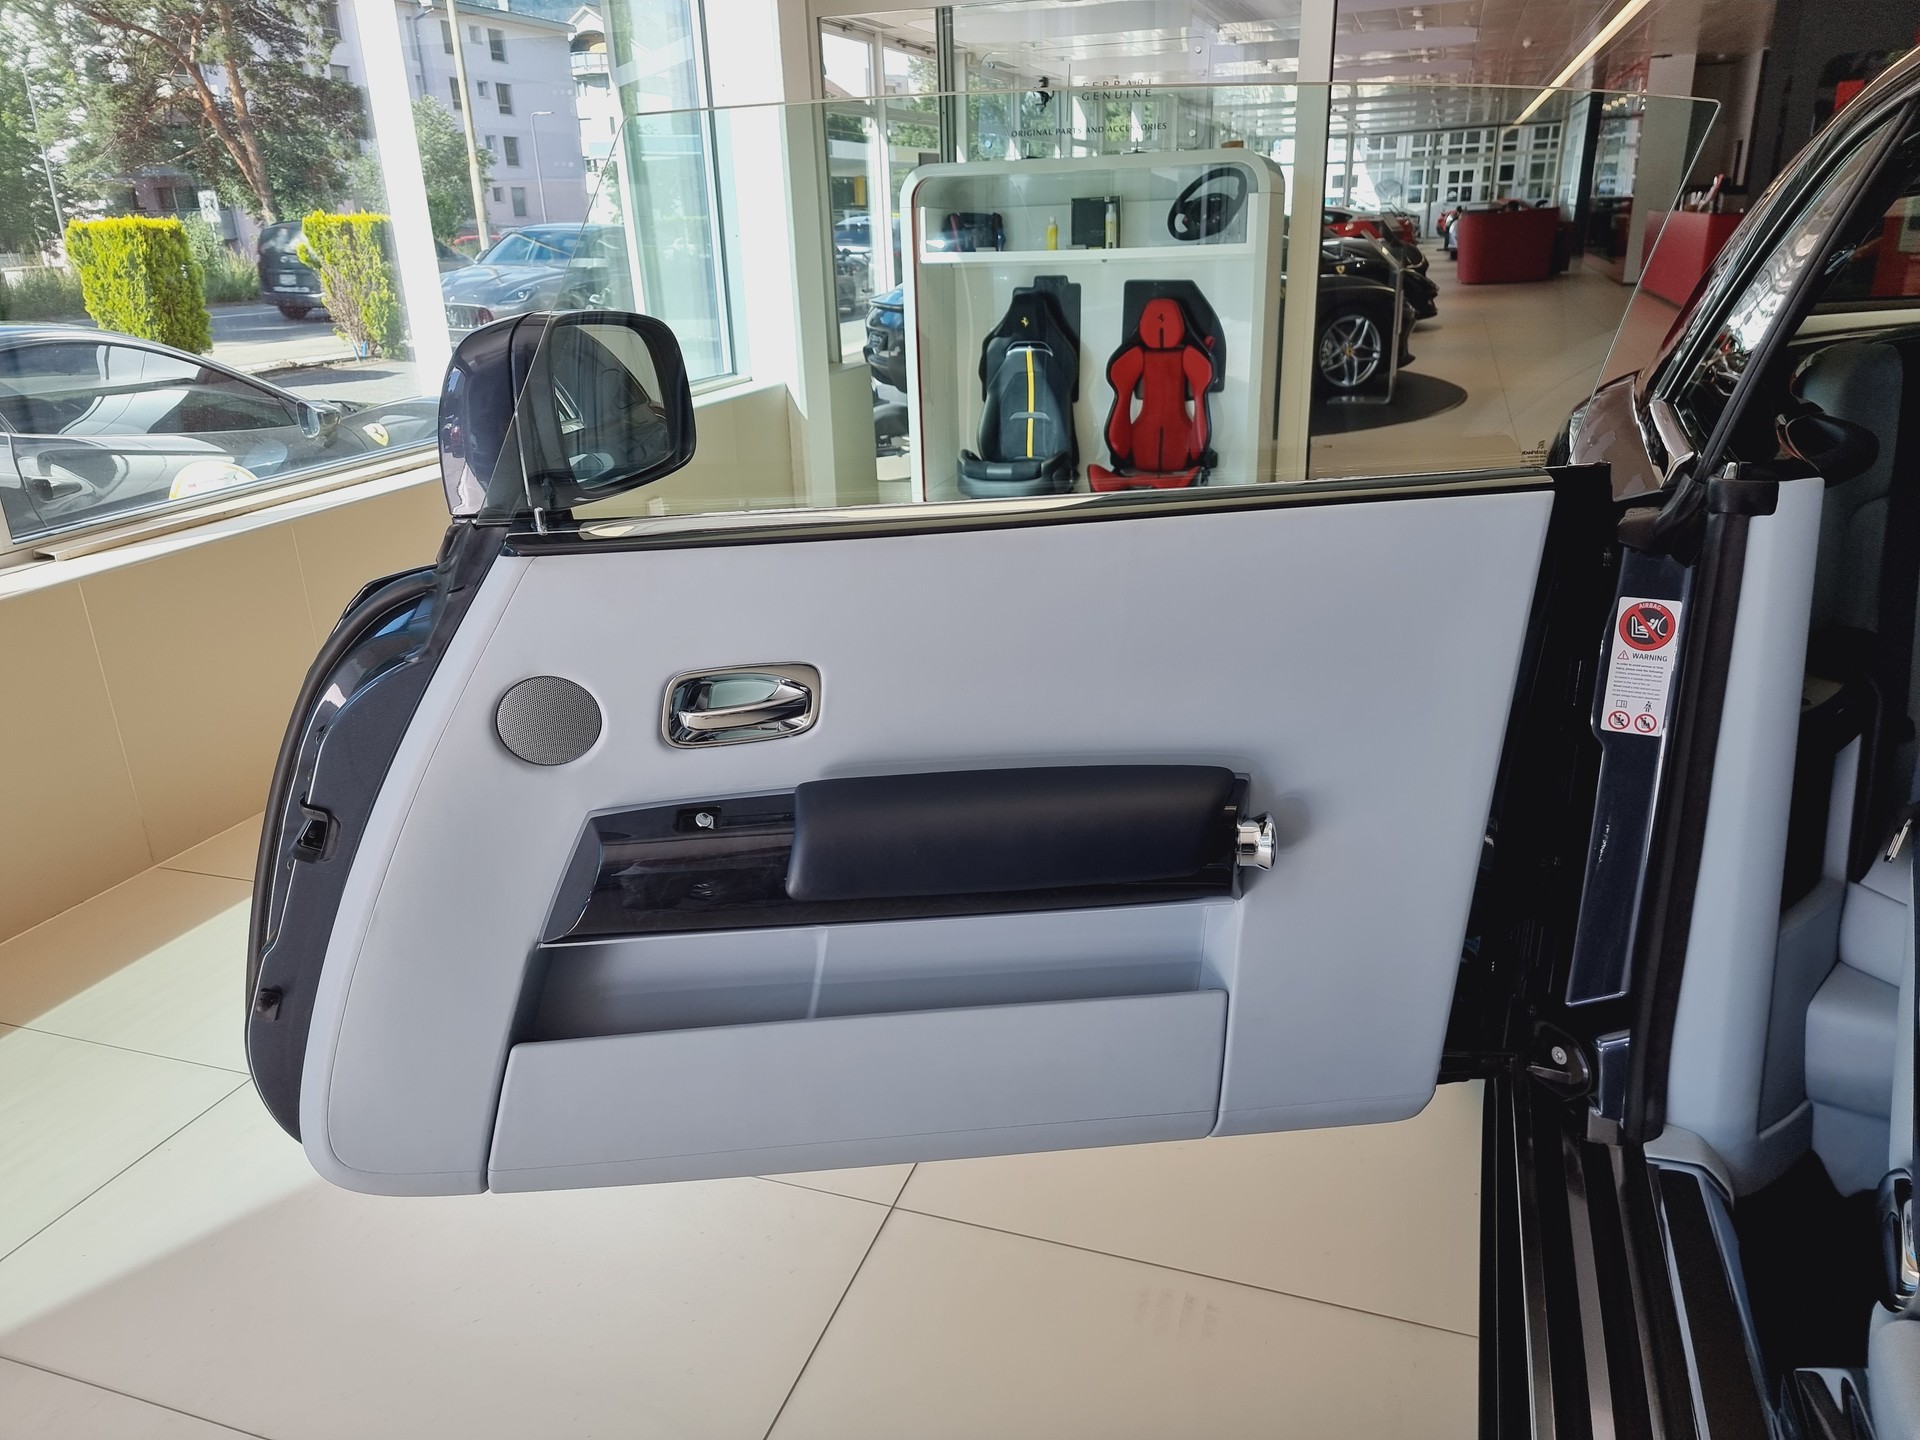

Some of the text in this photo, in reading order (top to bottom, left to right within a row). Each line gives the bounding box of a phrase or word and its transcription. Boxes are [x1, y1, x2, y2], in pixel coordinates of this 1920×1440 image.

[1081, 88, 1152, 101] GENUINE
[1010, 128, 1053, 138] ORIGINAL
[1086, 125, 1105, 134] AND
[1106, 122, 1168, 133] ACCEORIES
[1638, 602, 1662, 611] AIRBAG
[1632, 652, 1668, 662] WARNING
